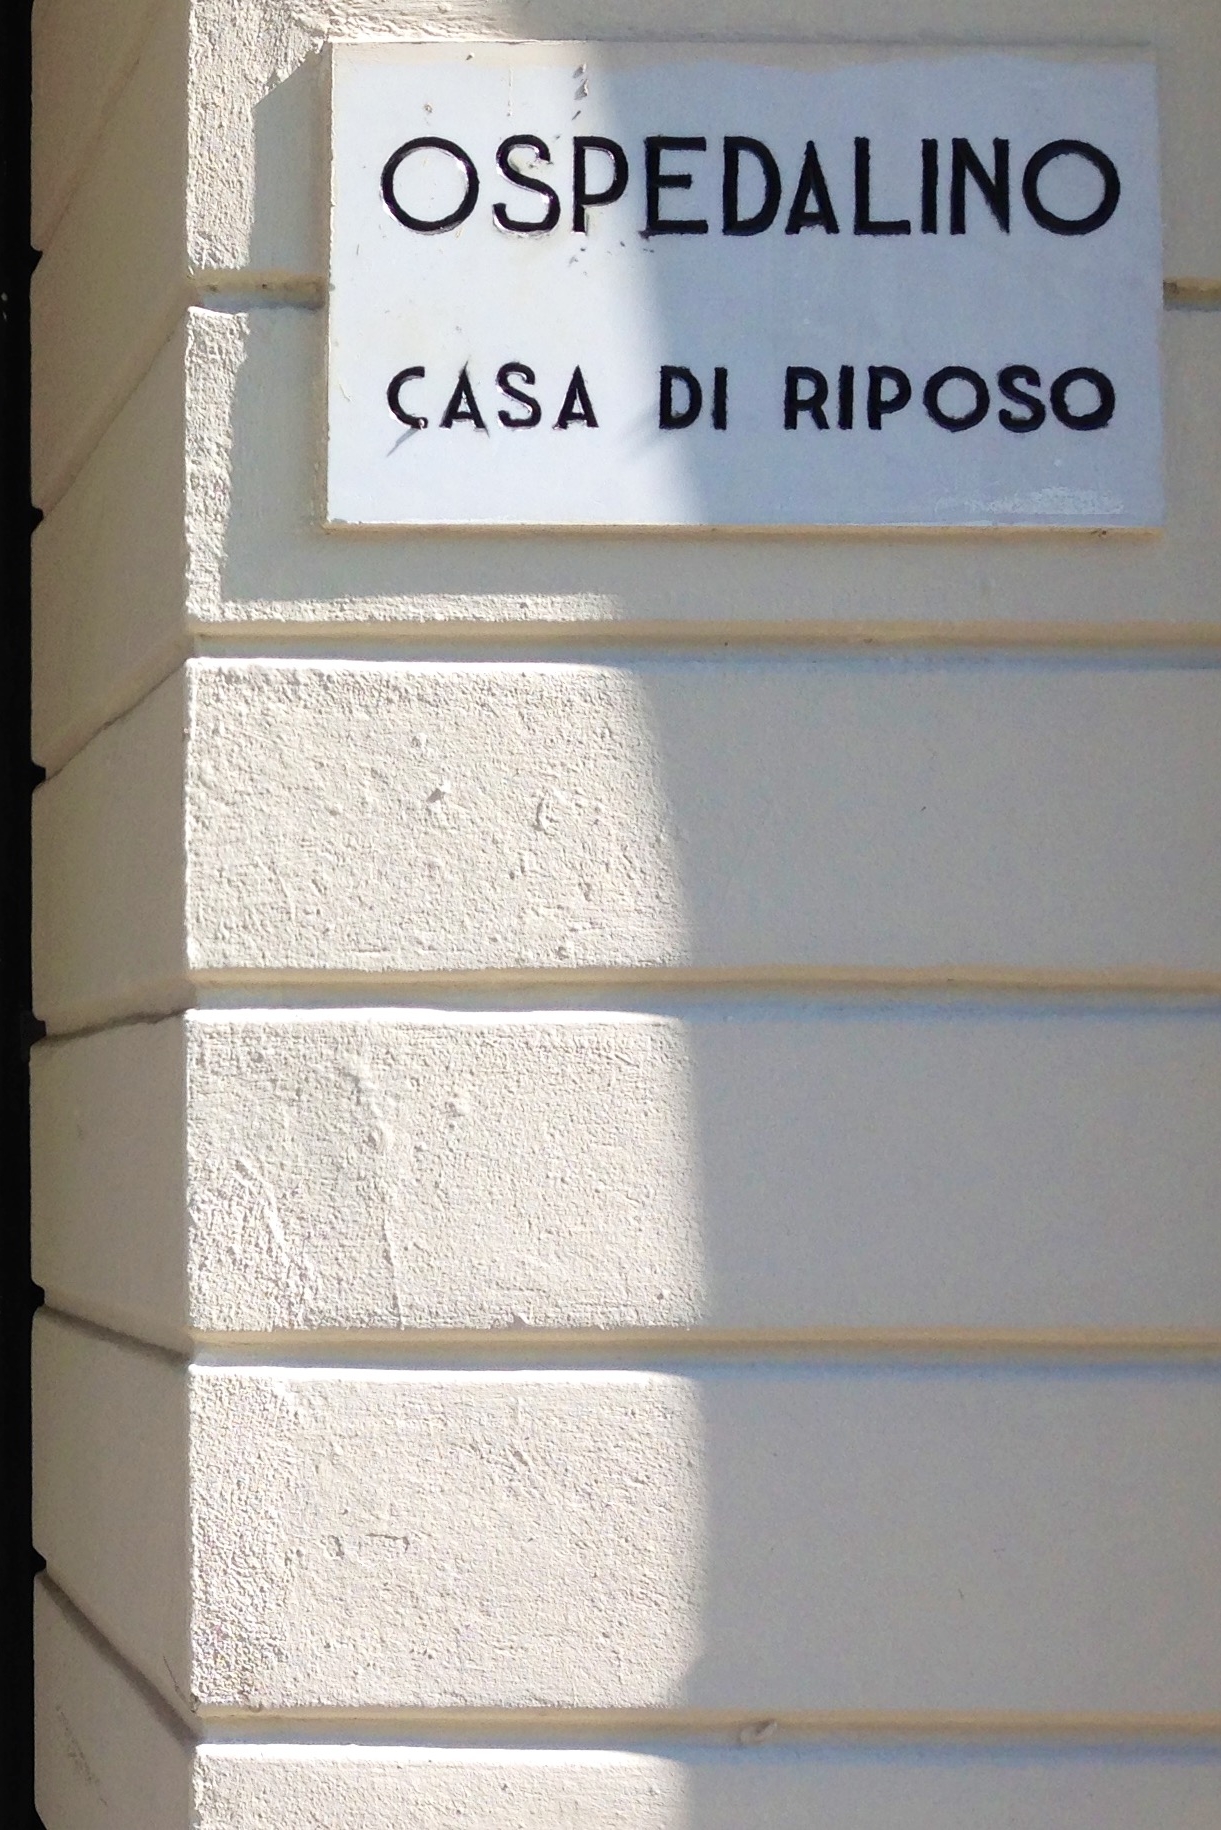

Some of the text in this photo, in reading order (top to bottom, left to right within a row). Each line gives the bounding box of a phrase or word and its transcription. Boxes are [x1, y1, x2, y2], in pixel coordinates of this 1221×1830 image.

[380, 134, 1122, 238] OSPEDALINO
[386, 362, 1117, 434] CASA DI RIPOSO
